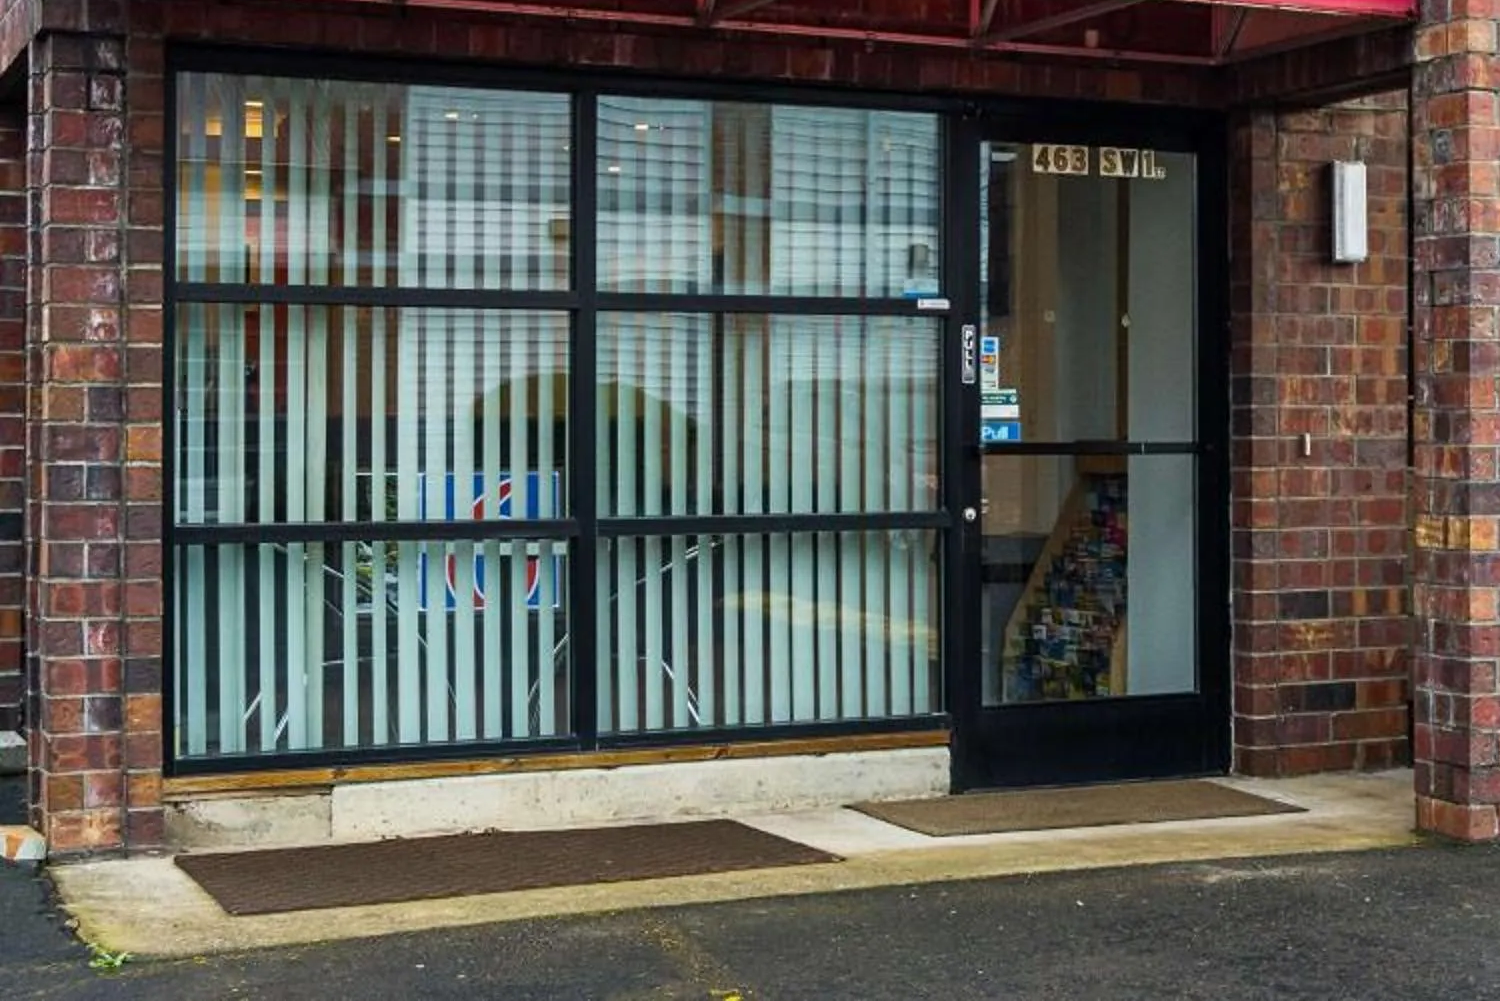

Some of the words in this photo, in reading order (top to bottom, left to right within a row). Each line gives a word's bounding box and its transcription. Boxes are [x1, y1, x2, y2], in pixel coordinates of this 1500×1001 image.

[1035, 146, 1087, 173] 463
[1102, 149, 1138, 176] SW
[982, 426, 1009, 440] Pull
